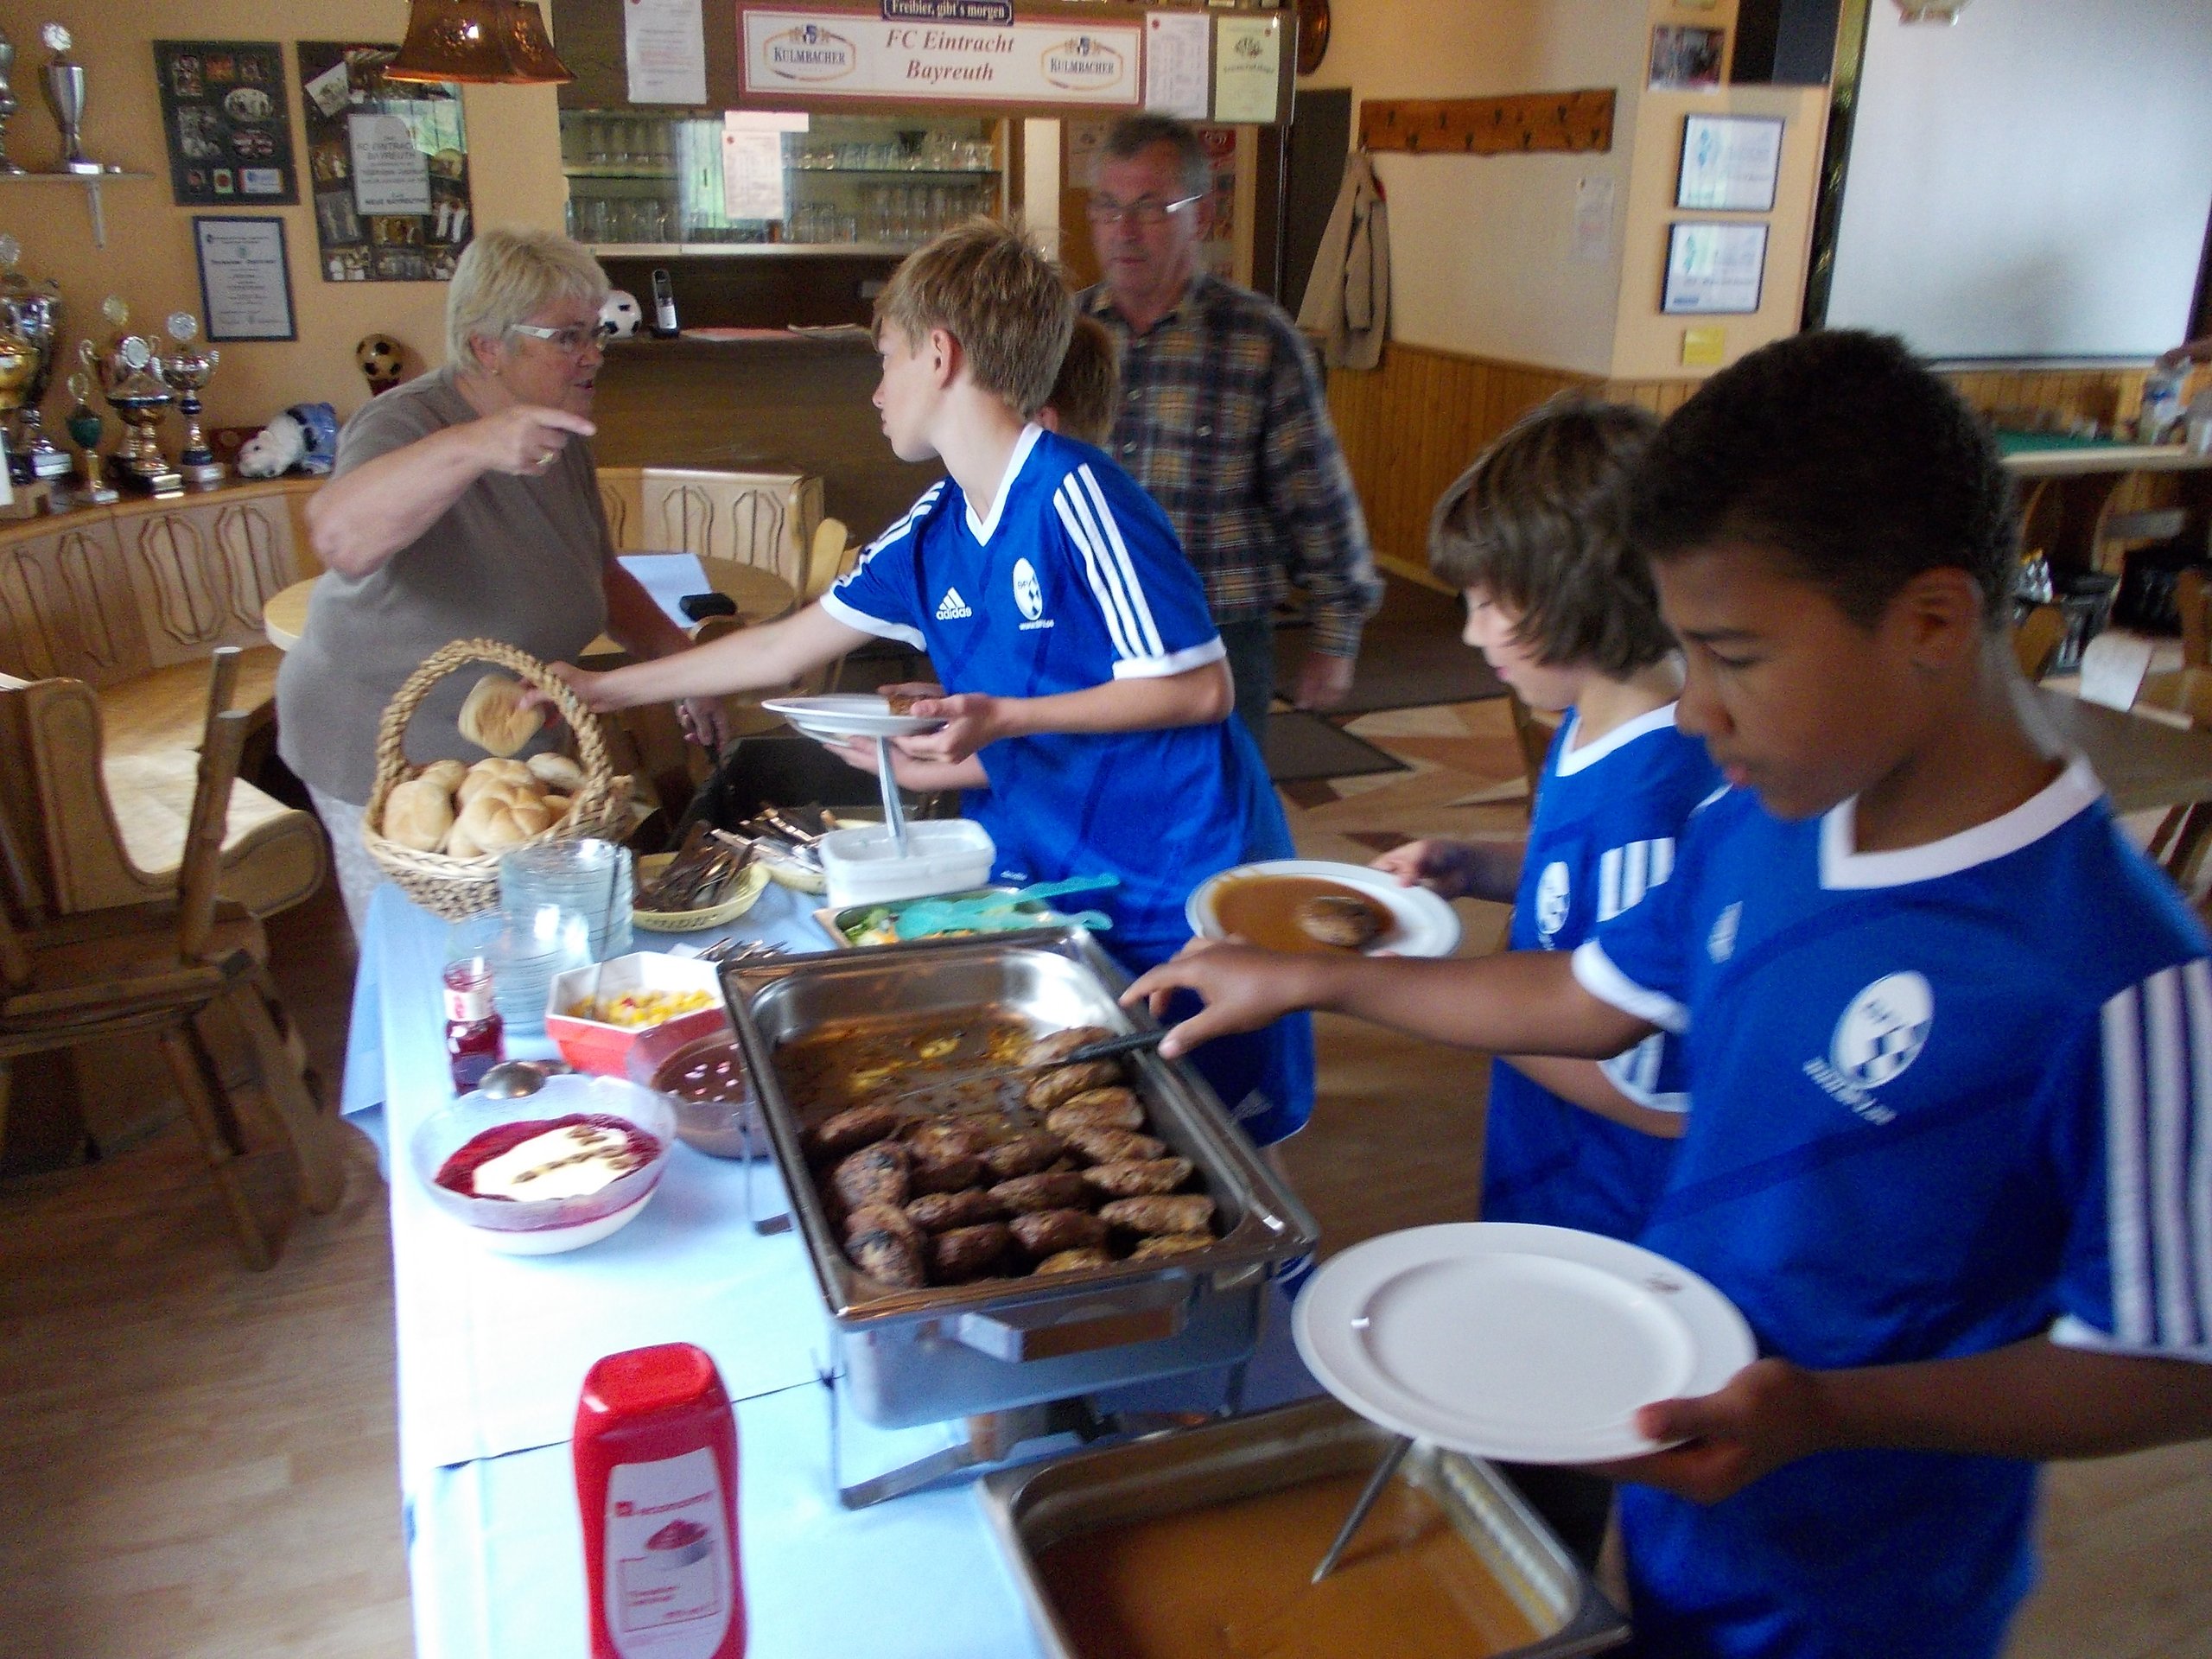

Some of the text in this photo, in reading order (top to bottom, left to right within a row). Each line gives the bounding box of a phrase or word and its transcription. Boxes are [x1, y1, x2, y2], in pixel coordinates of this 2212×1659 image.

[967, 6, 1005, 20] morgen
[886, 29, 1015, 53] FC Eintracht
[774, 47, 846, 65] KULMBACHER
[906, 60, 995, 84] Bayreuth
[1050, 58, 1114, 75] KULMBACHER
[936, 607, 973, 620] adidas
